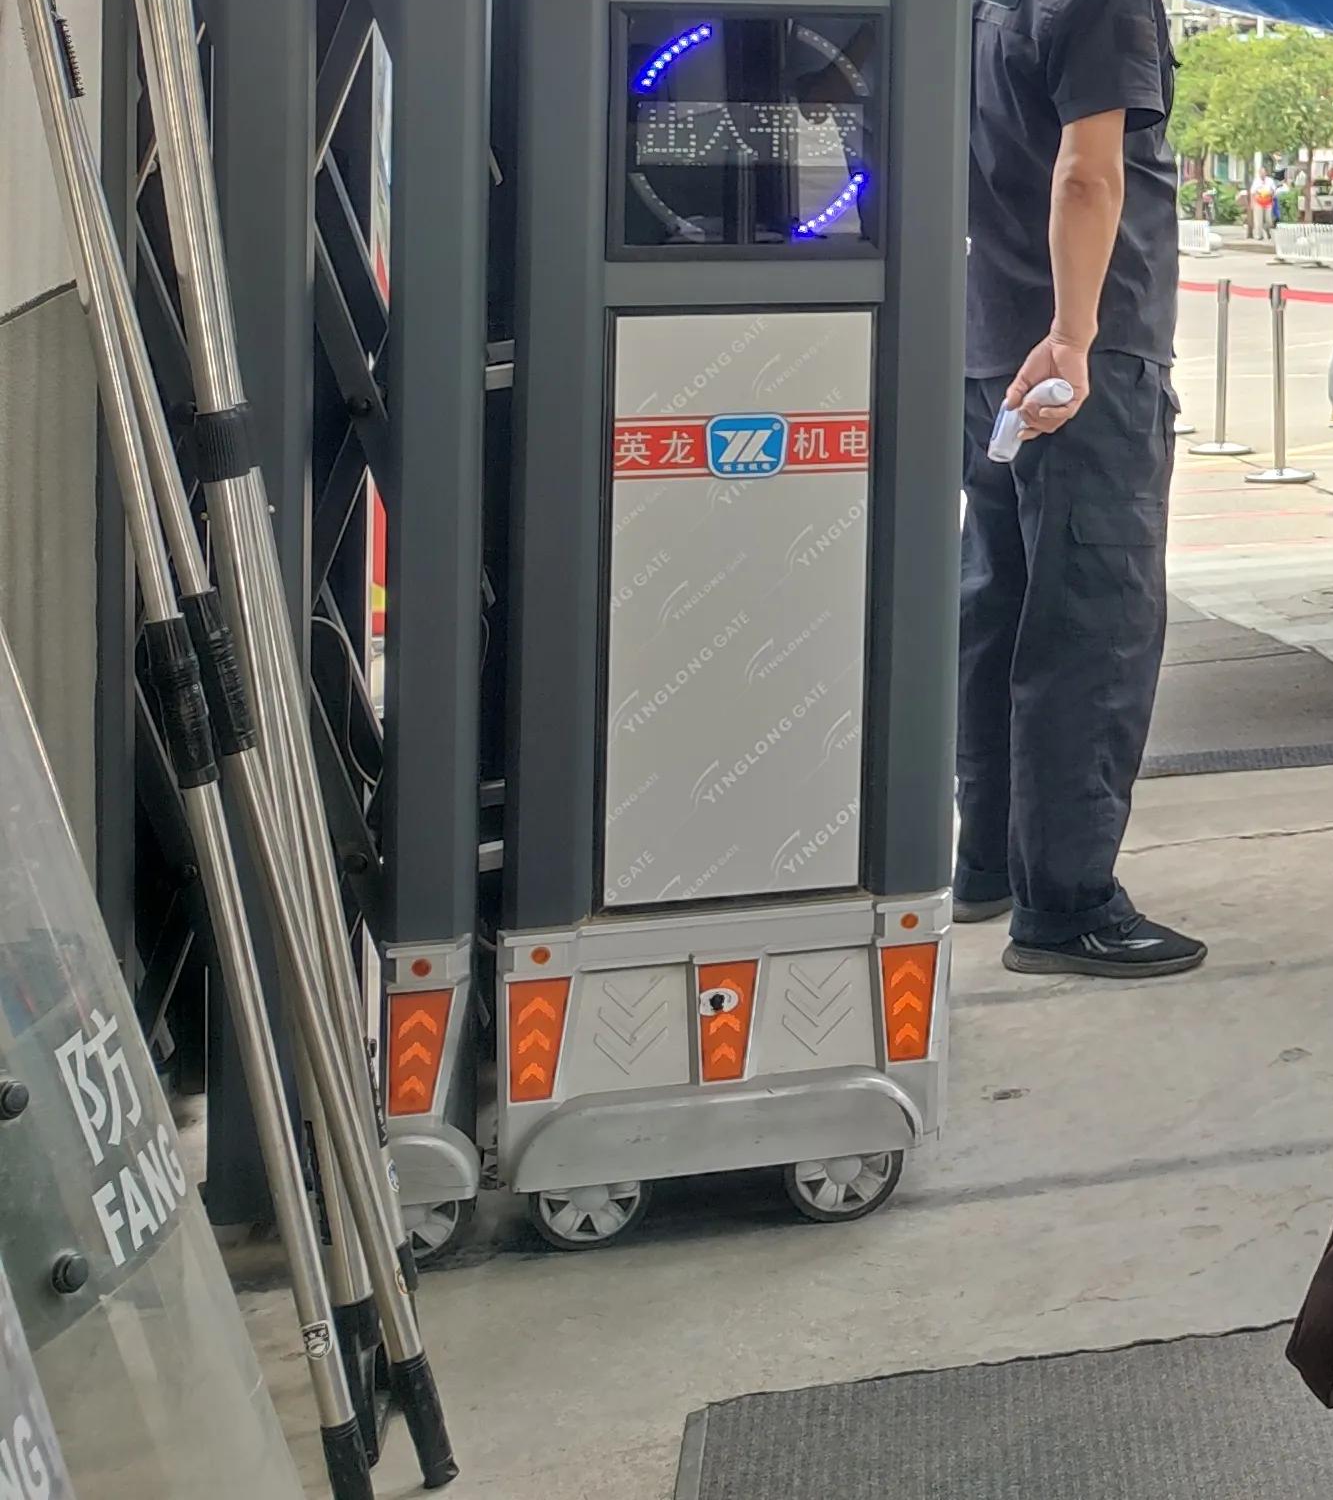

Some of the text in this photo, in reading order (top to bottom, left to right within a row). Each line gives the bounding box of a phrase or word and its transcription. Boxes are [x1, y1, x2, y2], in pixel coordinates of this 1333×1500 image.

[615, 426, 869, 466] 英龙 机电
[623, 645, 714, 734] YINGLONG
[703, 716, 794, 806] YINGLONG
[55, 1009, 141, 1167] 防
[91, 1123, 188, 1268] FANG
